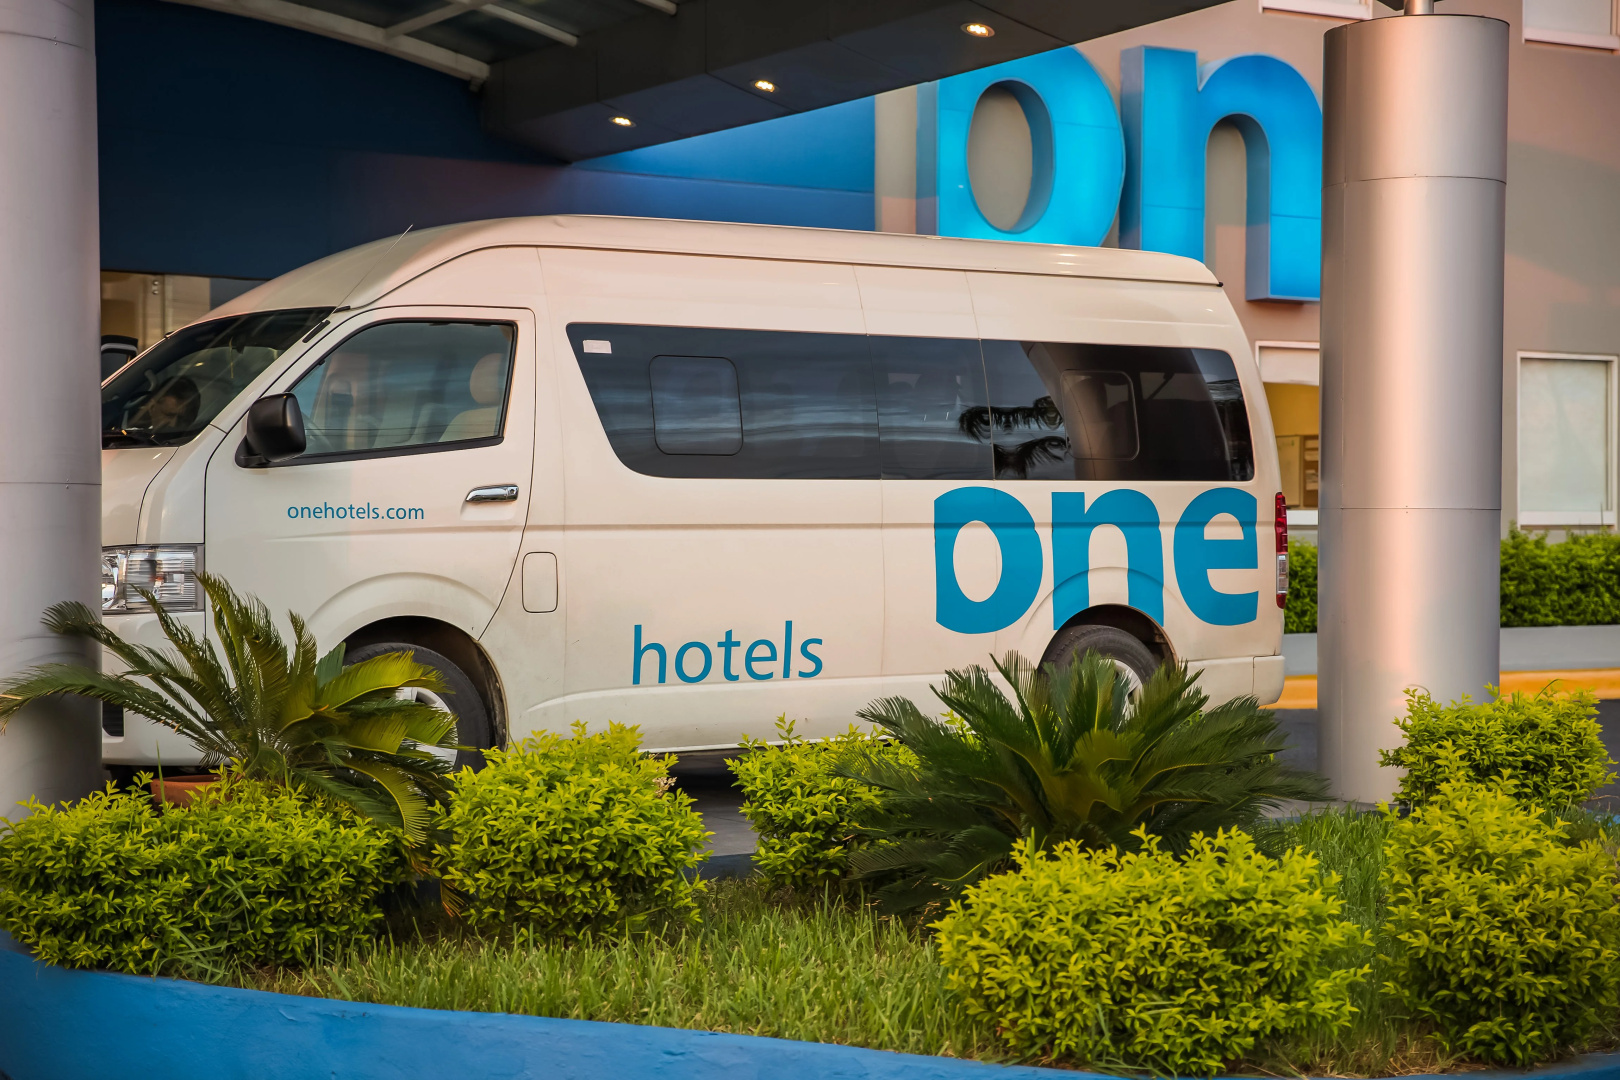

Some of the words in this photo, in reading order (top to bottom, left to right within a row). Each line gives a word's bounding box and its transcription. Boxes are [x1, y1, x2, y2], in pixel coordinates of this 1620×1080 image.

[287, 501, 425, 520] onehotels.com
[934, 486, 1259, 635] one
[632, 620, 824, 686] hotels
